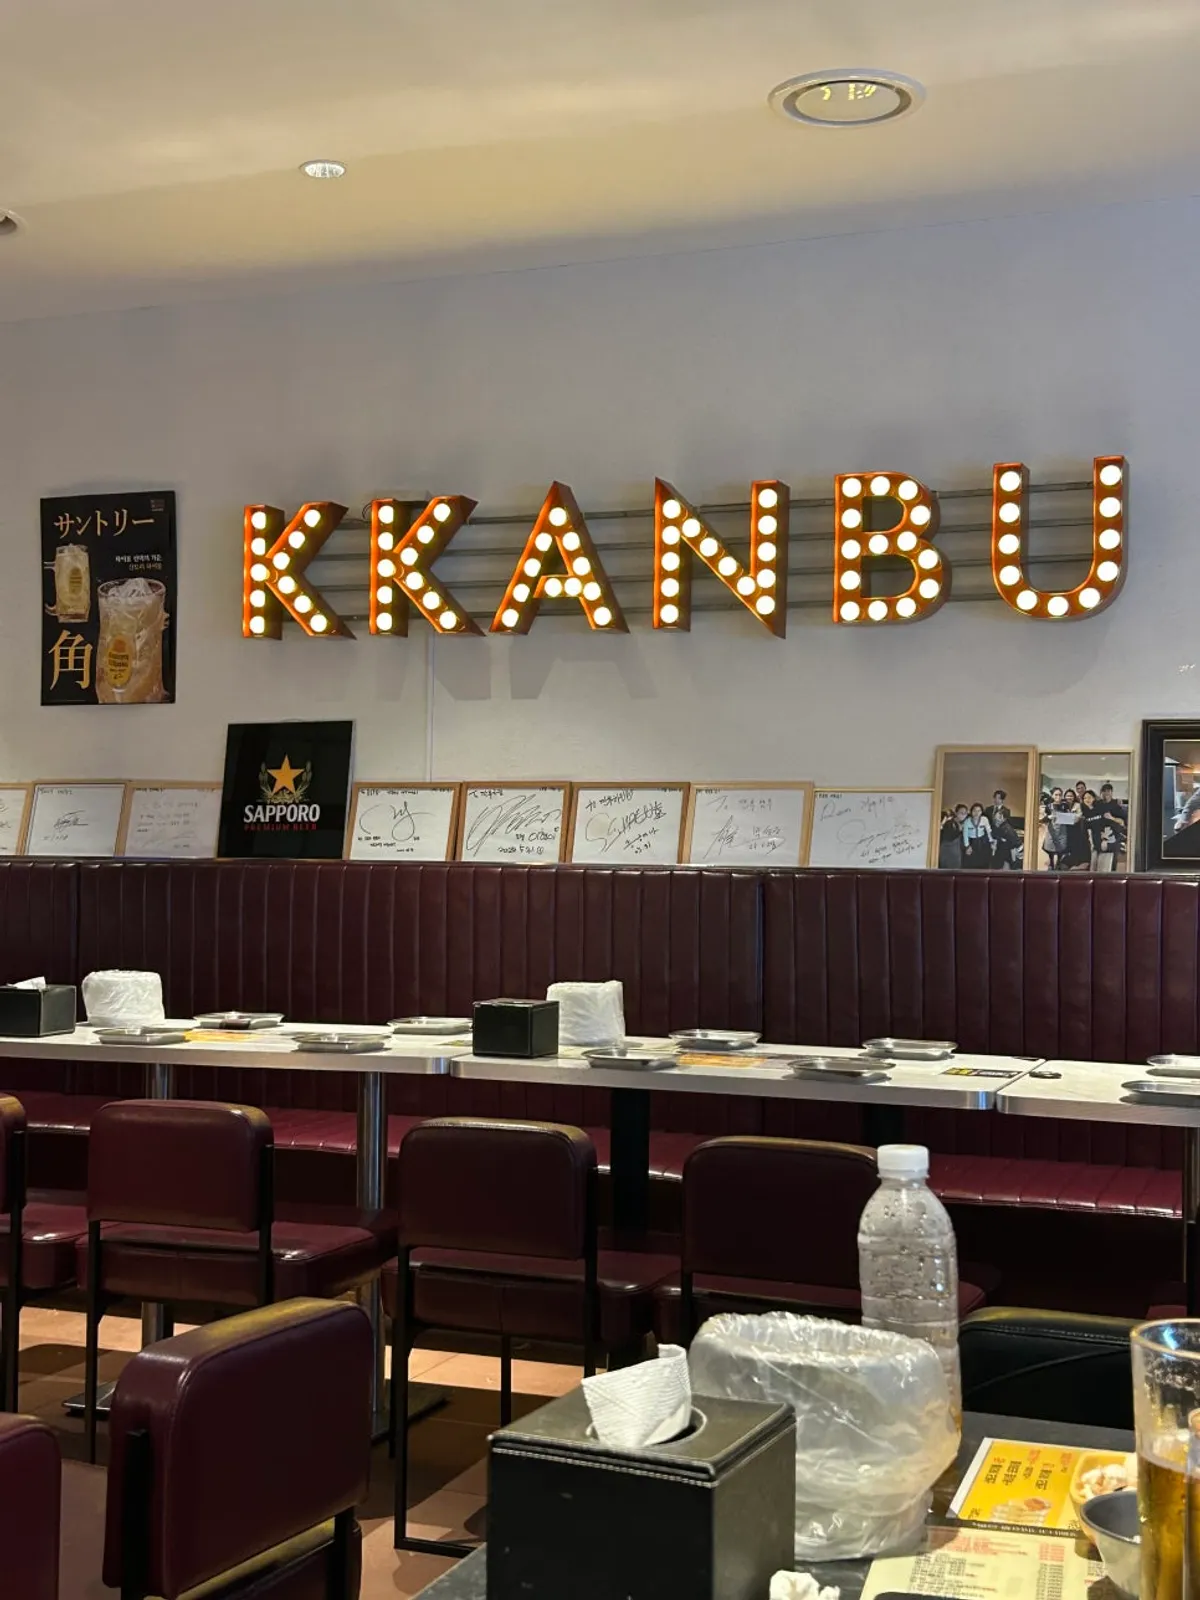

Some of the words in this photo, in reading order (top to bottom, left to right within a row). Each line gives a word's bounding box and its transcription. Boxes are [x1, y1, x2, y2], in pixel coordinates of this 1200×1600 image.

[53, 508, 155, 539] サントリー
[242, 455, 1128, 640] KKANBU
[48, 629, 93, 691] 角
[243, 803, 320, 823] SAPPORO
